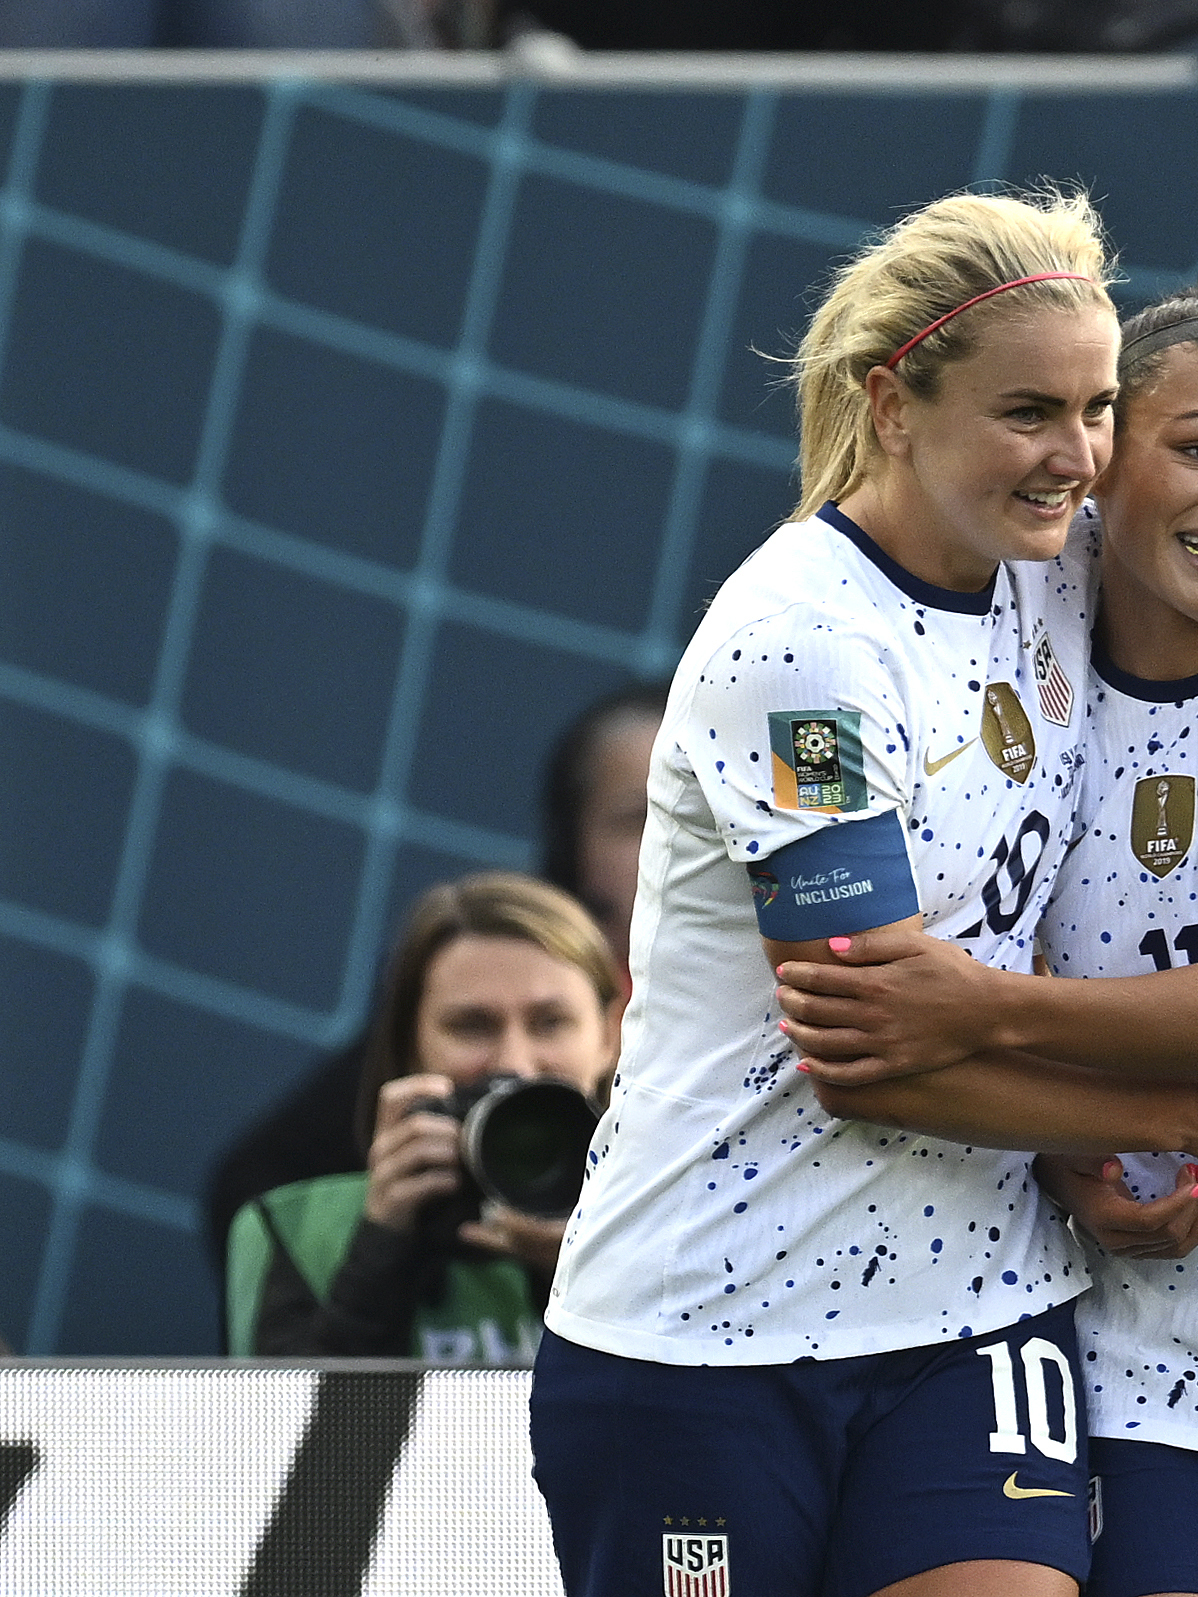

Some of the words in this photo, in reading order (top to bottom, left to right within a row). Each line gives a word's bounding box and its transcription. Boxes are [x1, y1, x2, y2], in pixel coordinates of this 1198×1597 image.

[1001, 743, 1027, 761] FIFA
[799, 785, 818, 796] AU
[821, 784, 841, 794] 20
[800, 796, 820, 806] NZ
[822, 794, 842, 804] 23
[1147, 838, 1177, 852] FIFA
[1153, 857, 1171, 866] 2019
[828, 867, 851, 883] For
[794, 879, 874, 905] INCLUSION
[975, 1336, 1078, 1465] 10
[666, 1538, 724, 1573] USA
